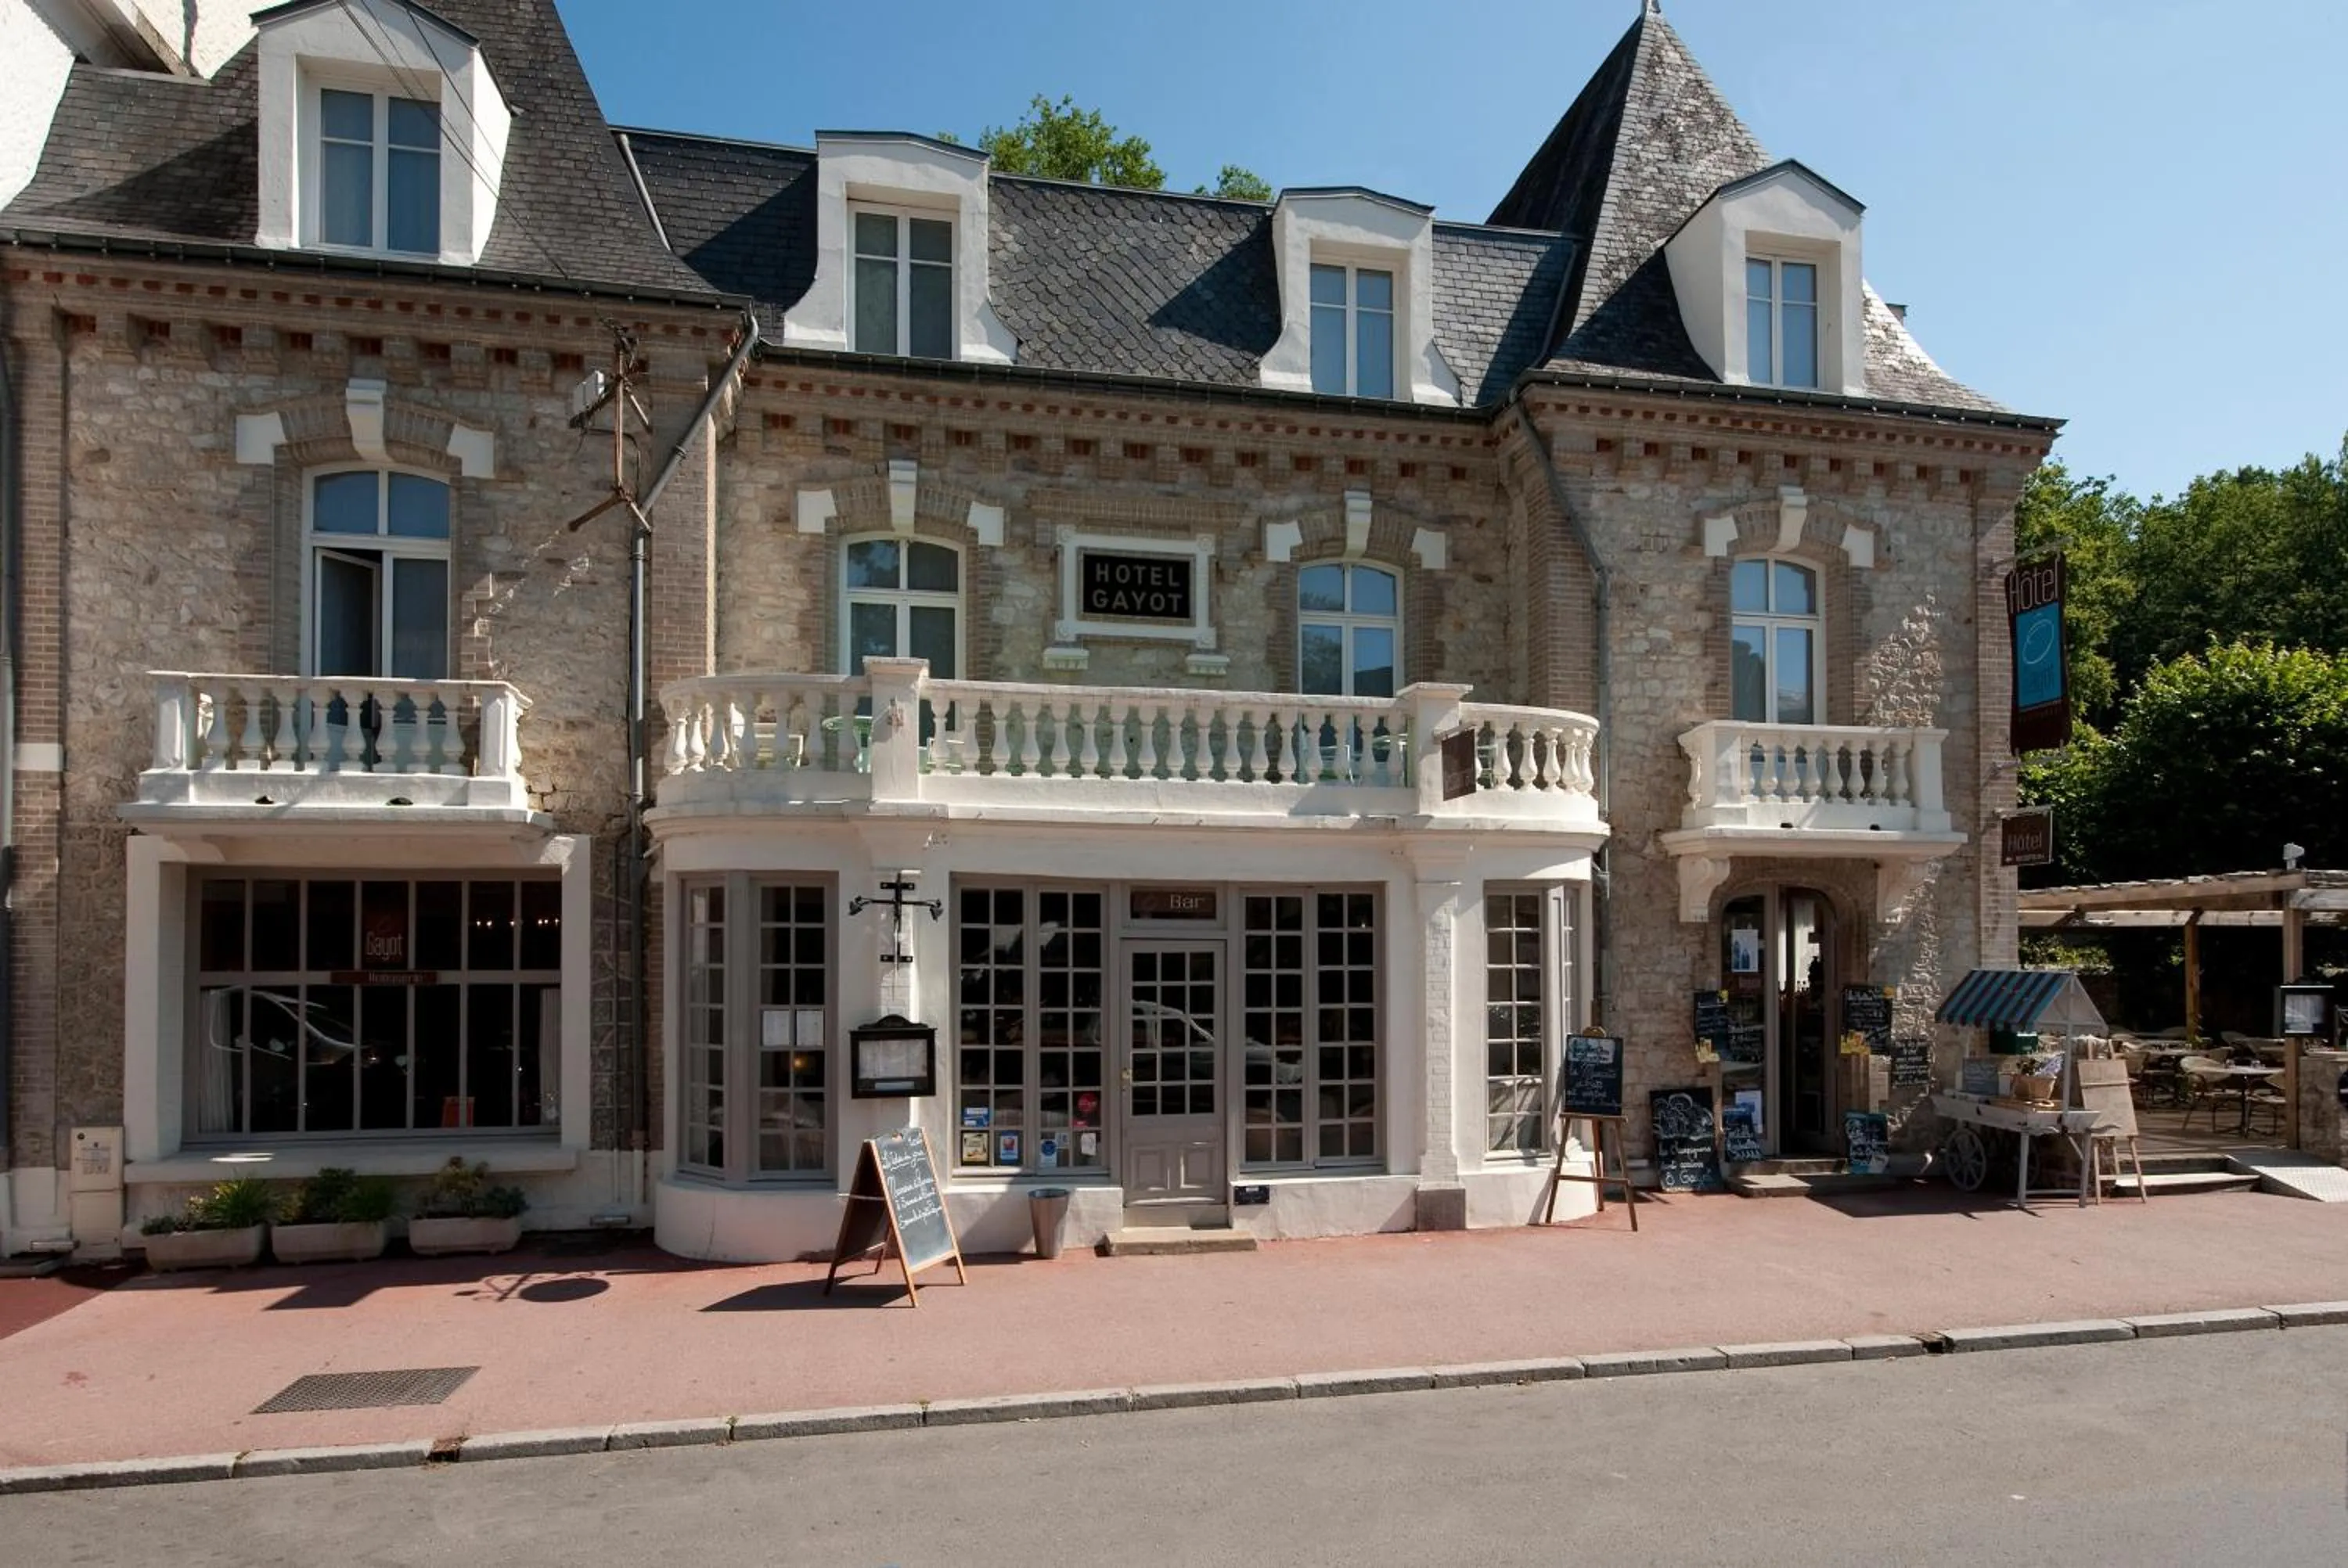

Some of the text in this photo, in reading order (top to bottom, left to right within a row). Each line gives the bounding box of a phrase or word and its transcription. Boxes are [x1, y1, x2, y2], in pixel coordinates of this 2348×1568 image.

[1096, 563, 1180, 587] HOTEL
[2009, 553, 2060, 614] Hôtel
[1092, 588, 1183, 613] GAYOT
[1169, 894, 1204, 909] Bar
[366, 930, 404, 961] Gayot
